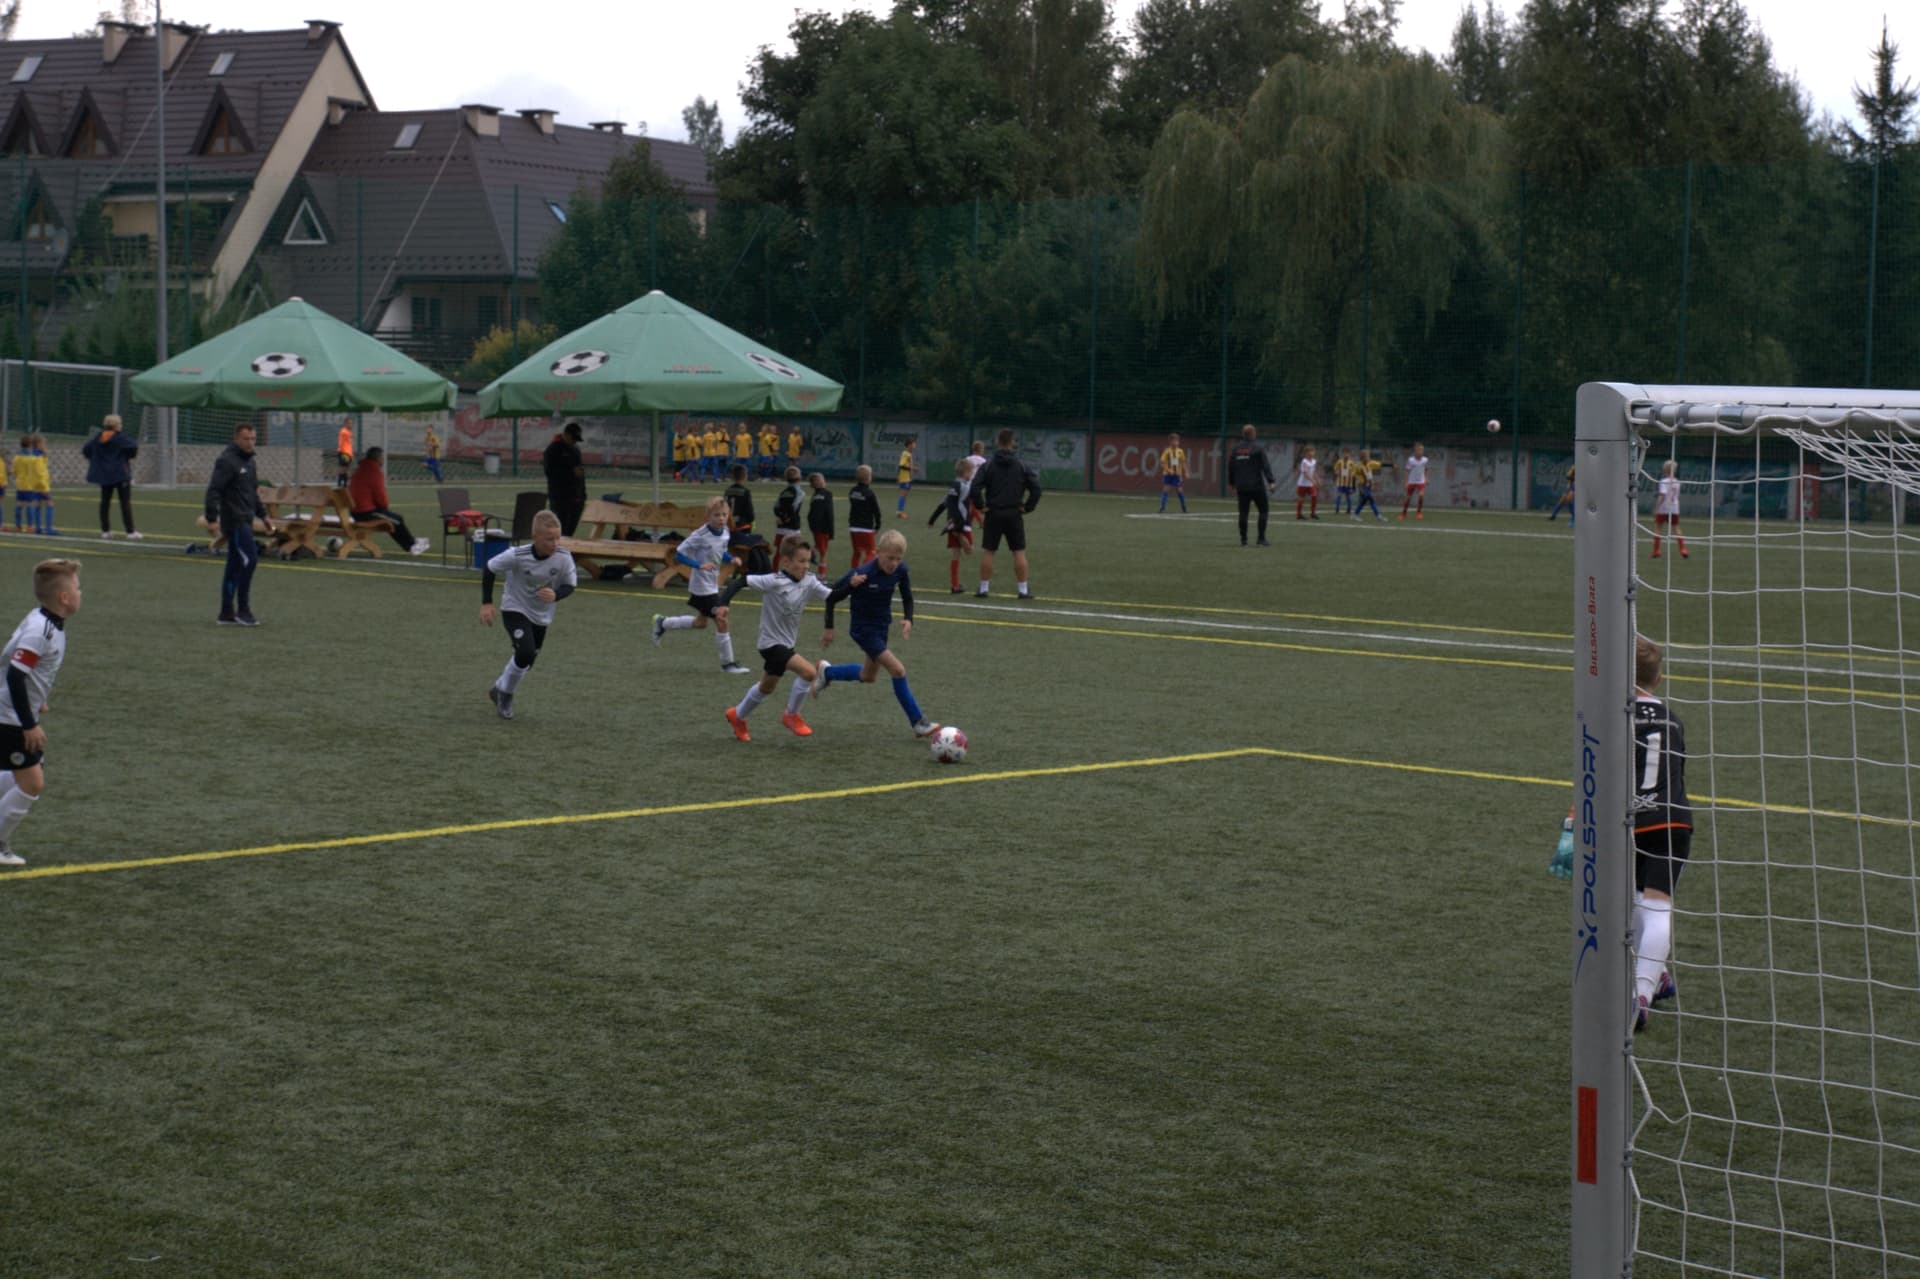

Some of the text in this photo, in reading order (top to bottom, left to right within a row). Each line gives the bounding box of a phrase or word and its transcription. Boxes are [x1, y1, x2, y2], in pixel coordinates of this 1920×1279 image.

[1098, 438, 1222, 481] ecout
[1640, 732, 1662, 790] 1
[1581, 723, 1600, 916] POLSPORT
